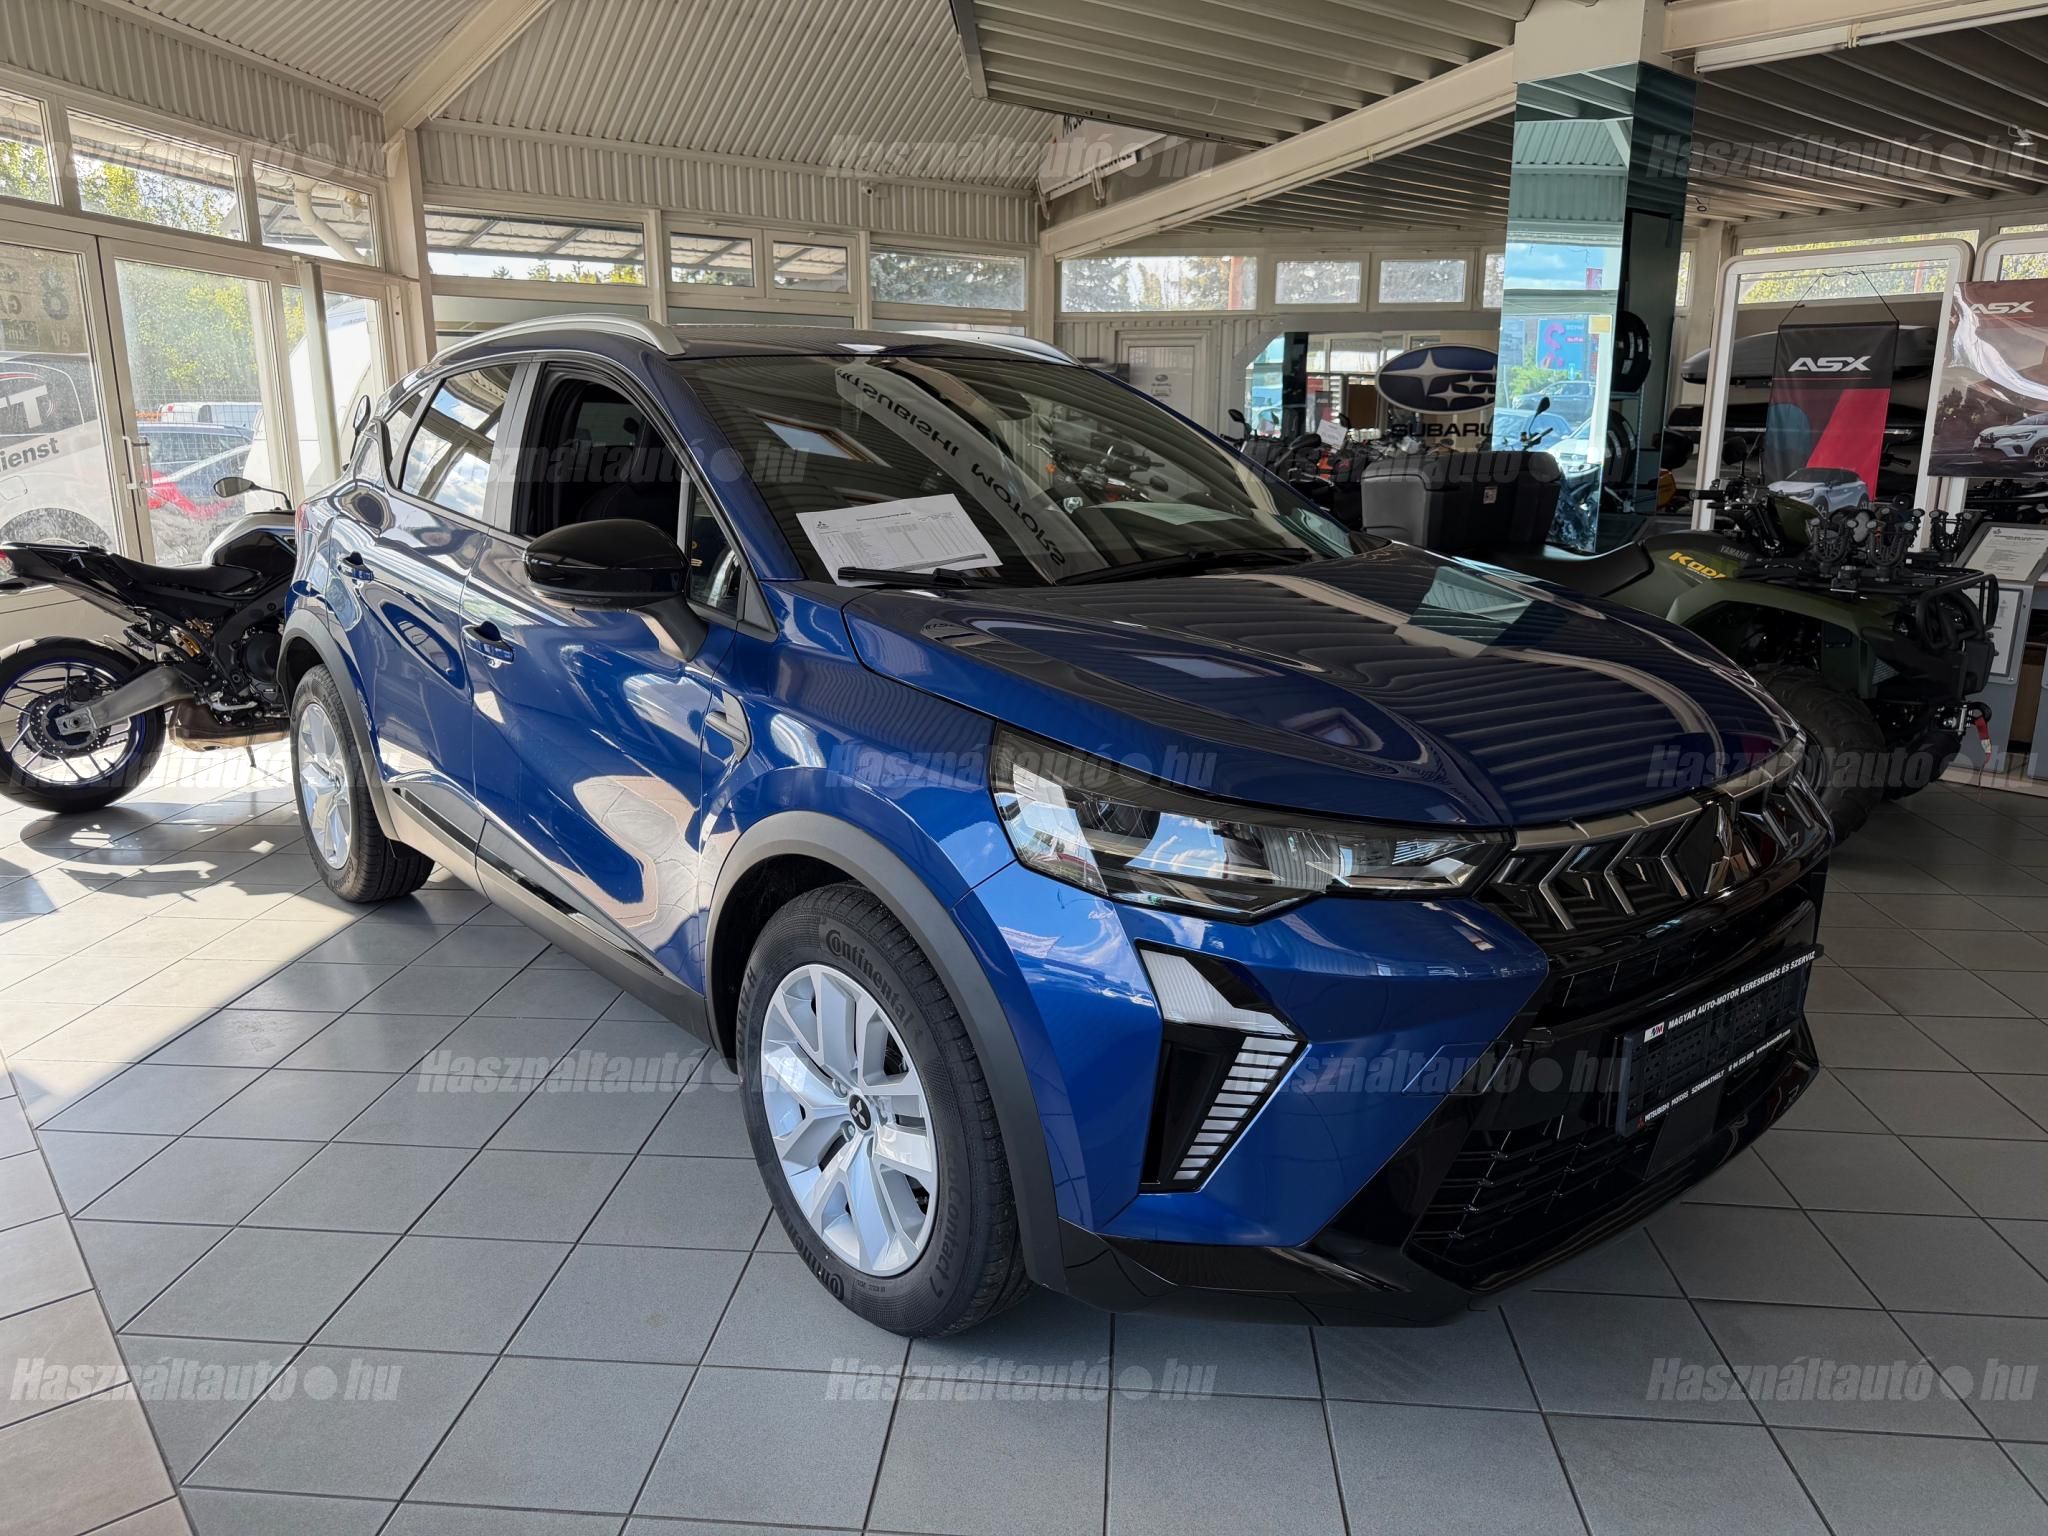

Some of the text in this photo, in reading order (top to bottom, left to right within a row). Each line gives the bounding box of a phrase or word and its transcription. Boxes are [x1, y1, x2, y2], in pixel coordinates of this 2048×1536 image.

[1970, 300, 2035, 314] ASX
[1788, 355, 1873, 373] ASX
[0, 437, 60, 472] ienst
[1719, 544, 1751, 561] YAMAHA
[826, 929, 914, 1028] Continental
[1667, 950, 1816, 1029] MAGYAR AUTO-MOTOR KERESKEDÉS ÉS SZERVIZ
